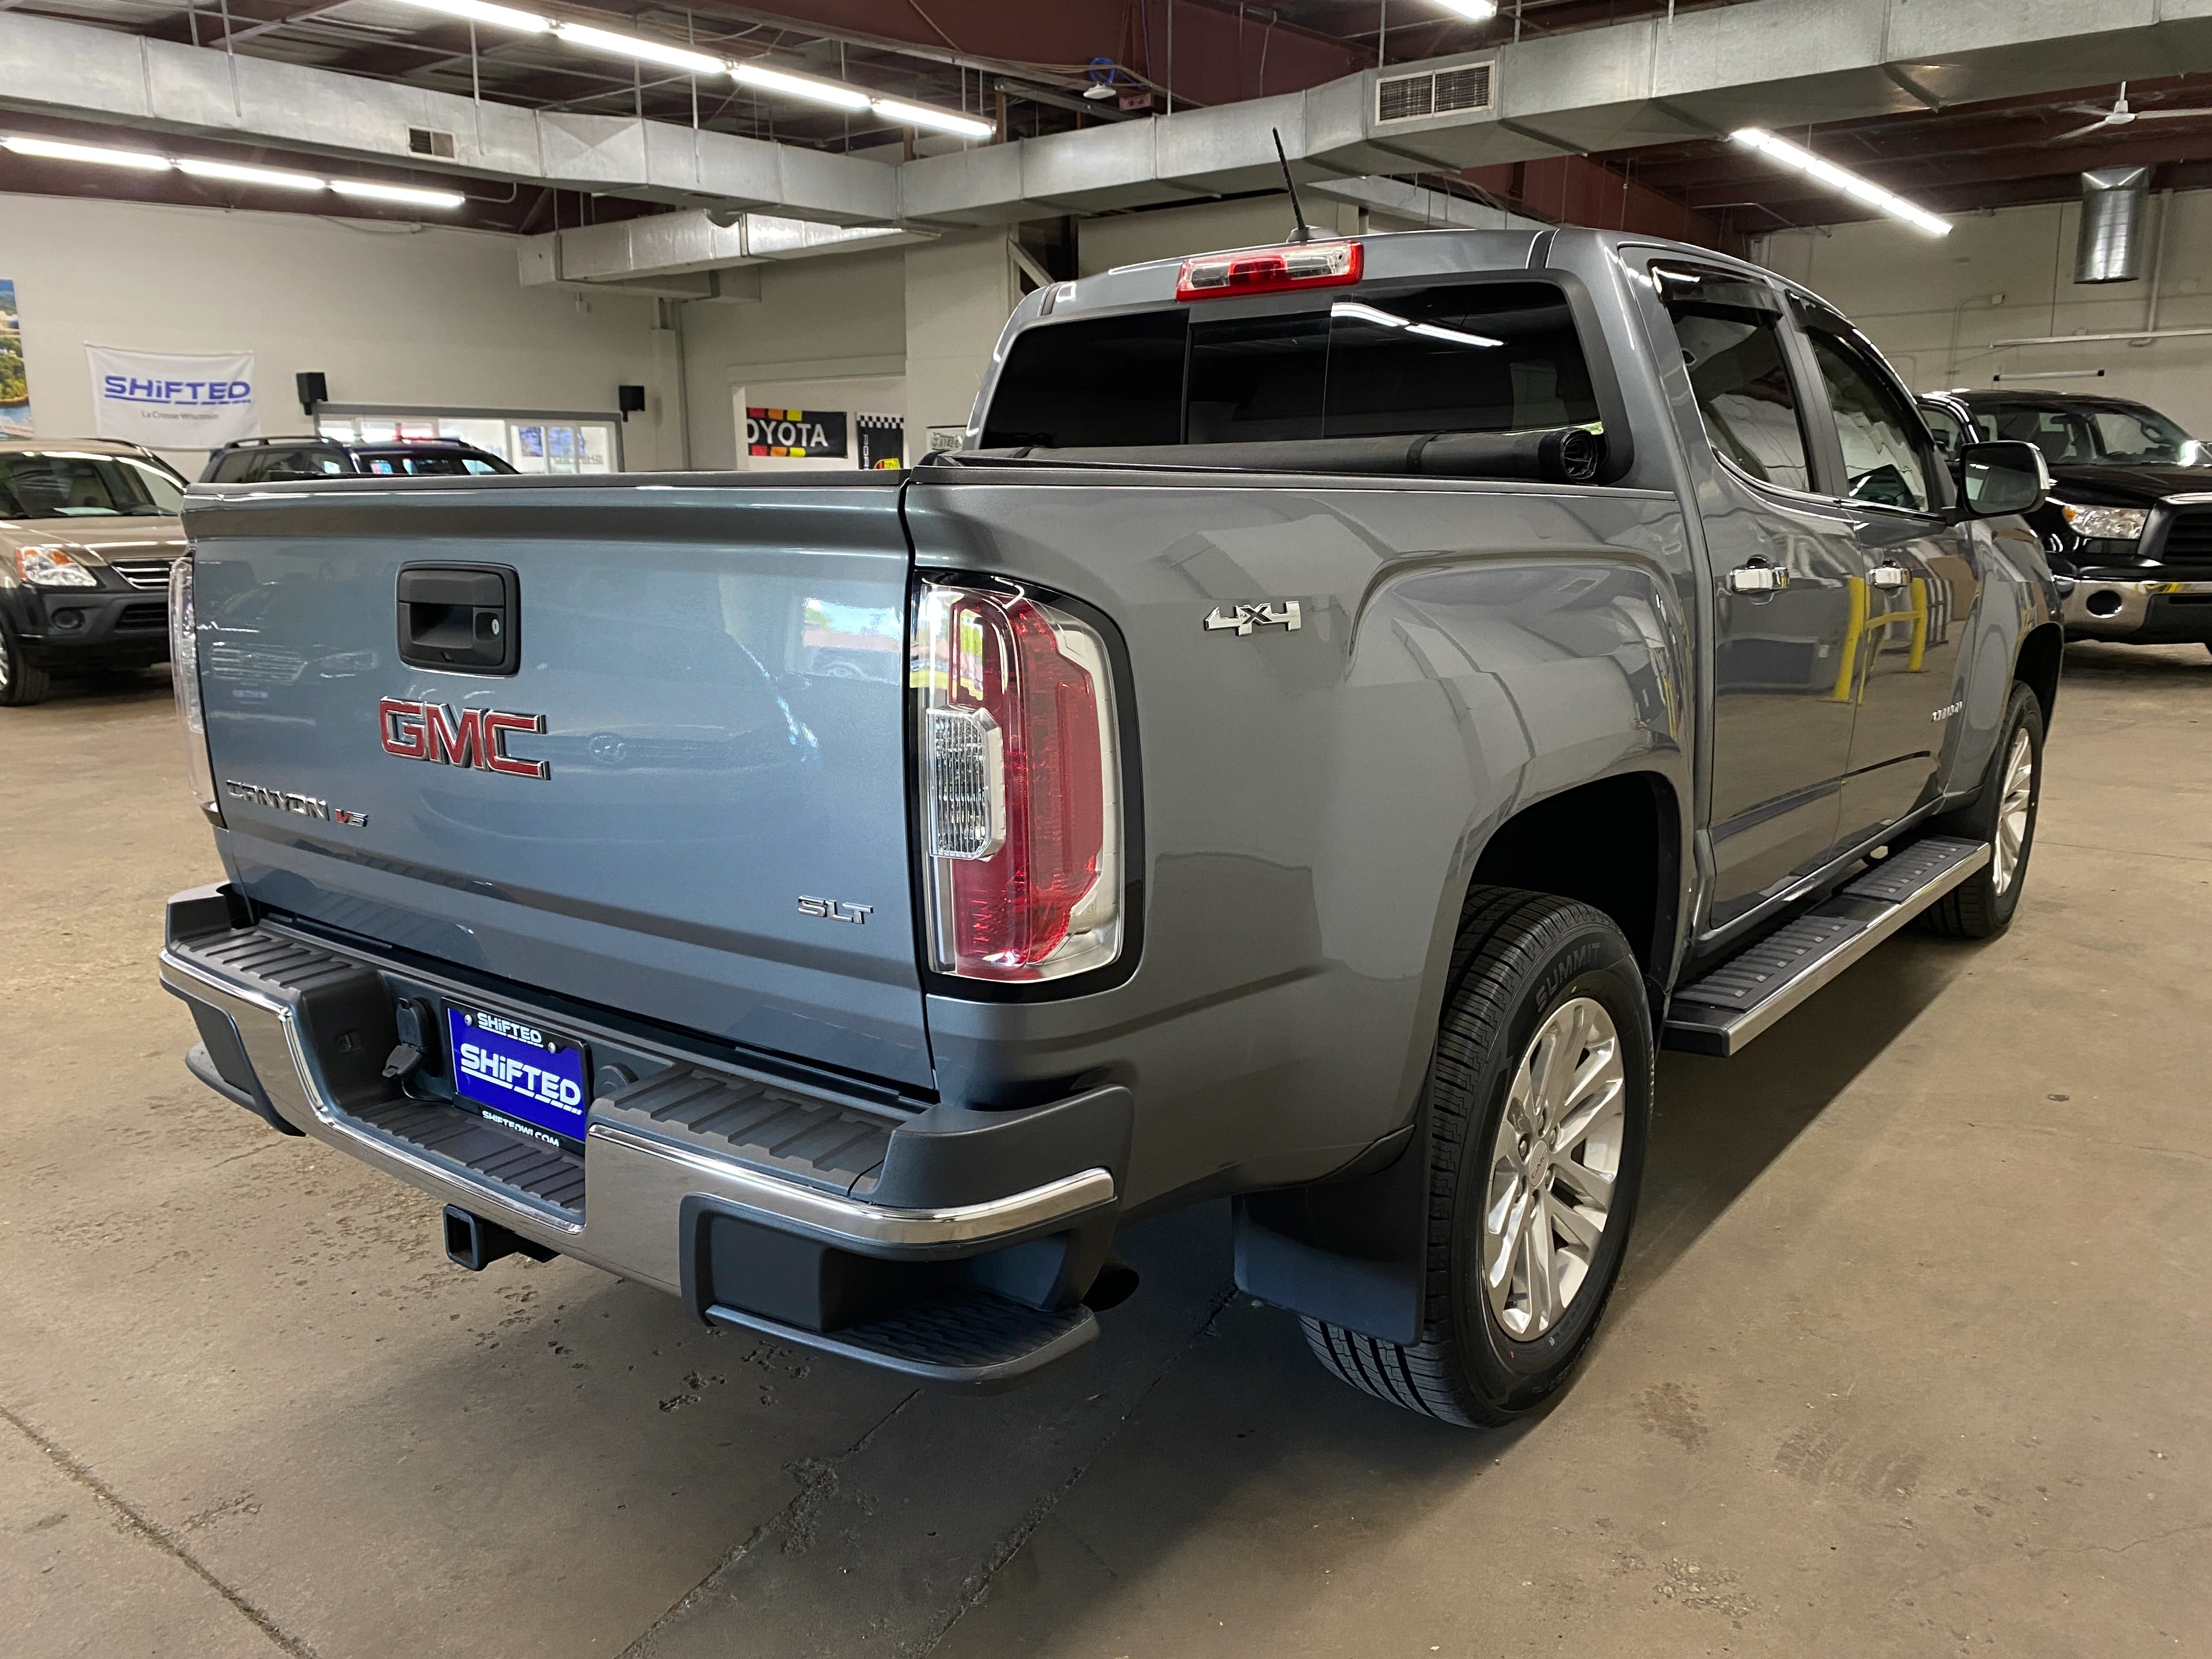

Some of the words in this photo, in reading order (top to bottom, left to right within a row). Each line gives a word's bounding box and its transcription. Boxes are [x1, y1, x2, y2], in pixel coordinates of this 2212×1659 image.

[379, 696, 551, 780] GMC
[227, 780, 330, 821] CANYON
[335, 808, 369, 827] V6
[798, 895, 874, 924] SLT
[1536, 942, 1601, 1013] SUMMIT
[482, 1110, 560, 1147] SHIFTEDWICOM
